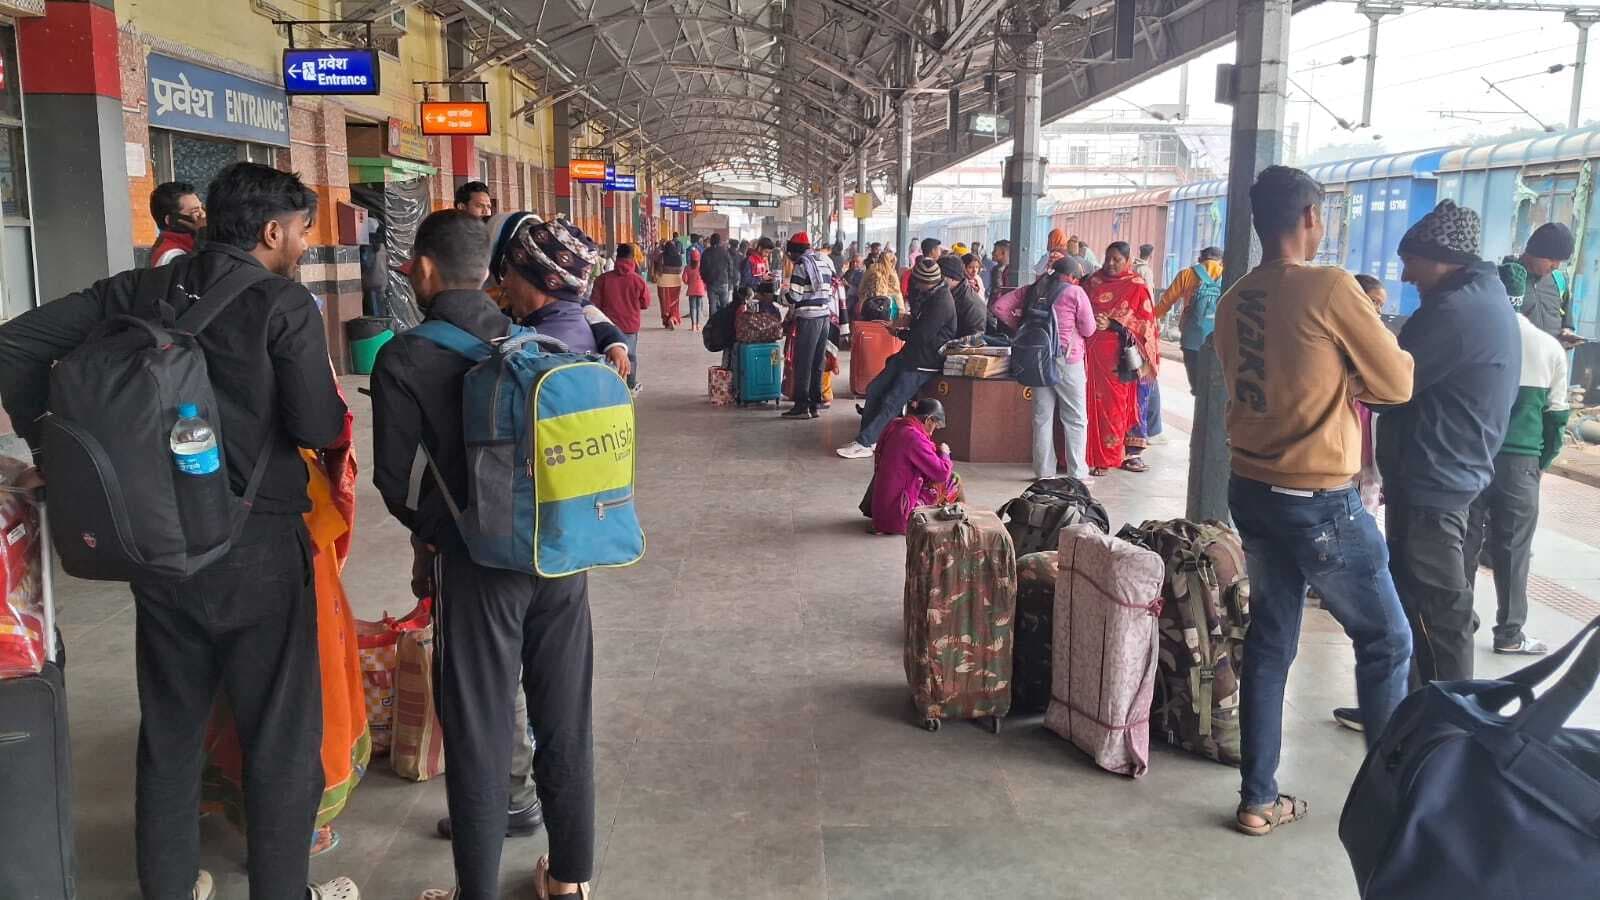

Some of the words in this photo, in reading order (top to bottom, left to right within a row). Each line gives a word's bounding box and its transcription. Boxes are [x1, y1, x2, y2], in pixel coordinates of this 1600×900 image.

[317, 54, 348, 71] प्रवेश
[317, 73, 367, 86] Entrance
[151, 72, 214, 119] प्रवेश
[225, 88, 286, 132] ENTRANCE
